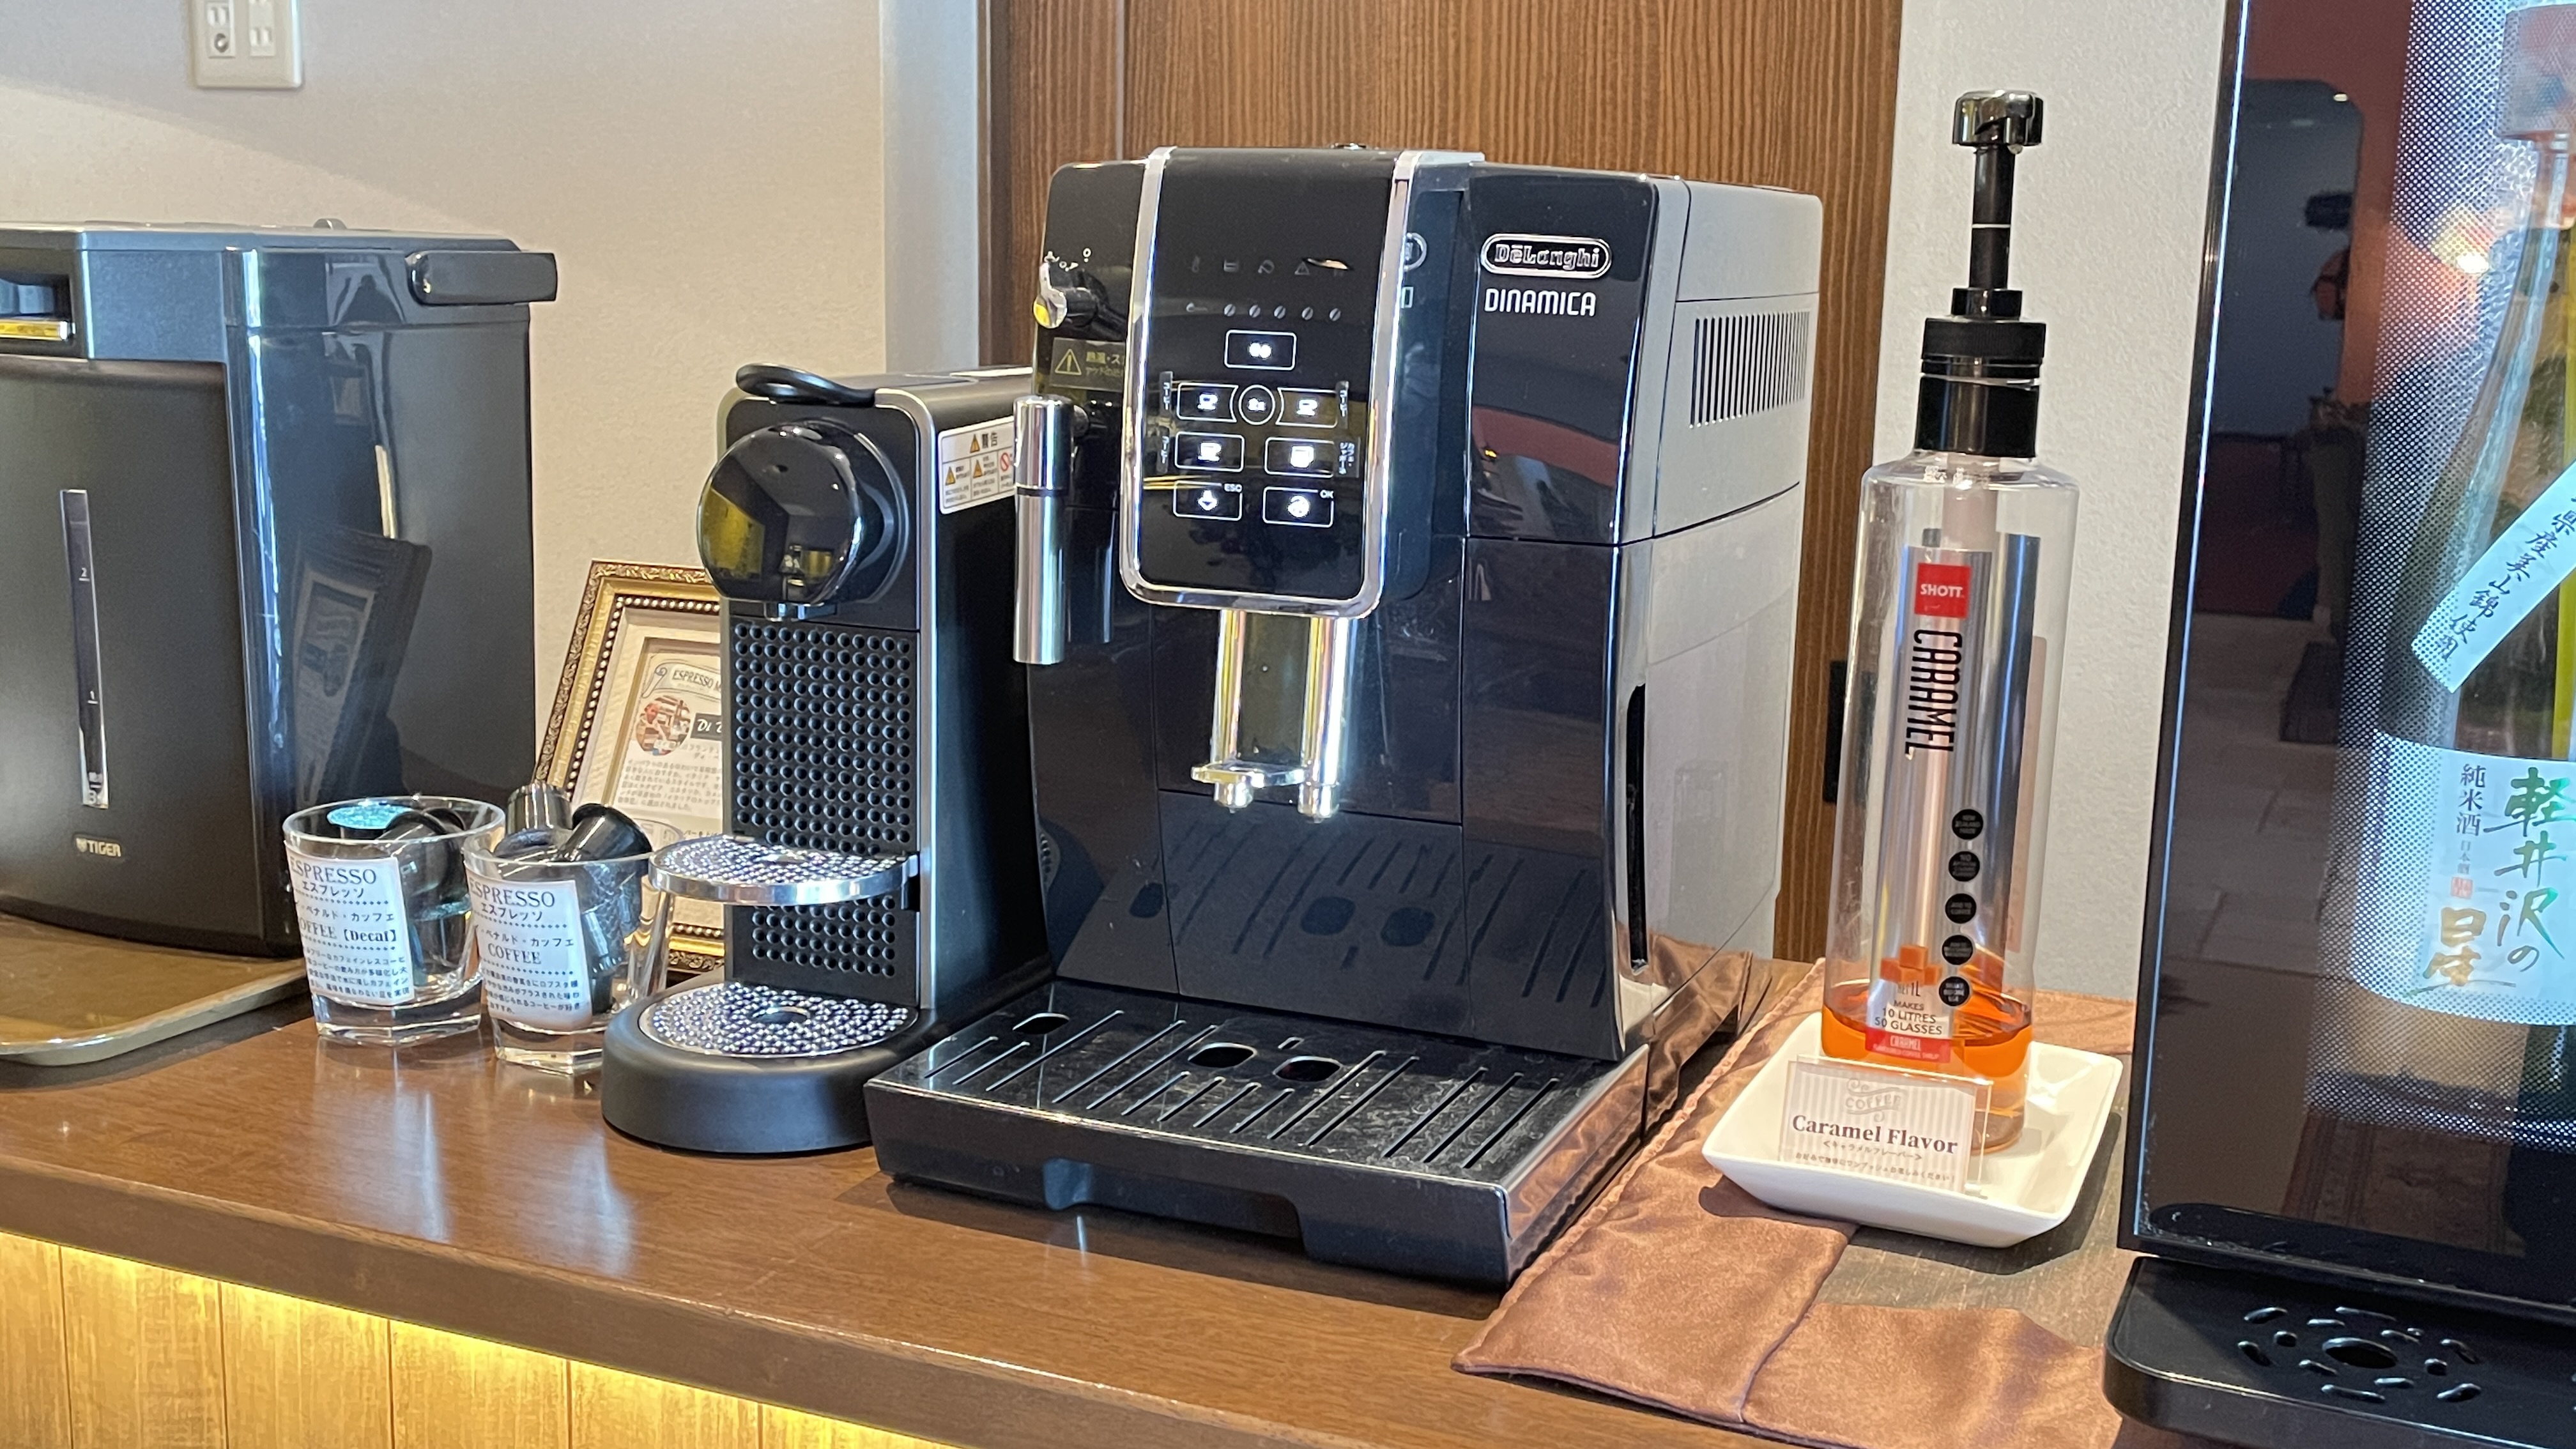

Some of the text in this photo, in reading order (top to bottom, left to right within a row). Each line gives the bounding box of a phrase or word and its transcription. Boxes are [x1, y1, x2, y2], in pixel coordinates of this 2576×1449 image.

[1484, 288, 1597, 317] DINAMICA
[1319, 489, 1335, 500] OK
[2435, 494, 2576, 663] 県産美山錦使用
[1920, 582, 1963, 599] SHOTT
[671, 668, 714, 689] ESPRESSO
[1904, 628, 1963, 755] CARAMEL
[2455, 762, 2487, 837] 純米酒
[87, 839, 122, 858] TIGER
[289, 855, 377, 885] ESPRESSO
[469, 877, 555, 908] ESPRESSO
[487, 942, 542, 965] COFFEE
[1910, 979, 1922, 998] 1L
[1893, 999, 1925, 1011] MAKES
[1882, 1007, 1937, 1025] 10 LITRES
[1890, 1020, 1943, 1036] GLASSES
[1844, 1093, 1903, 1110] COFFEE
[1792, 1114, 1959, 1155] Caramel Flavor
